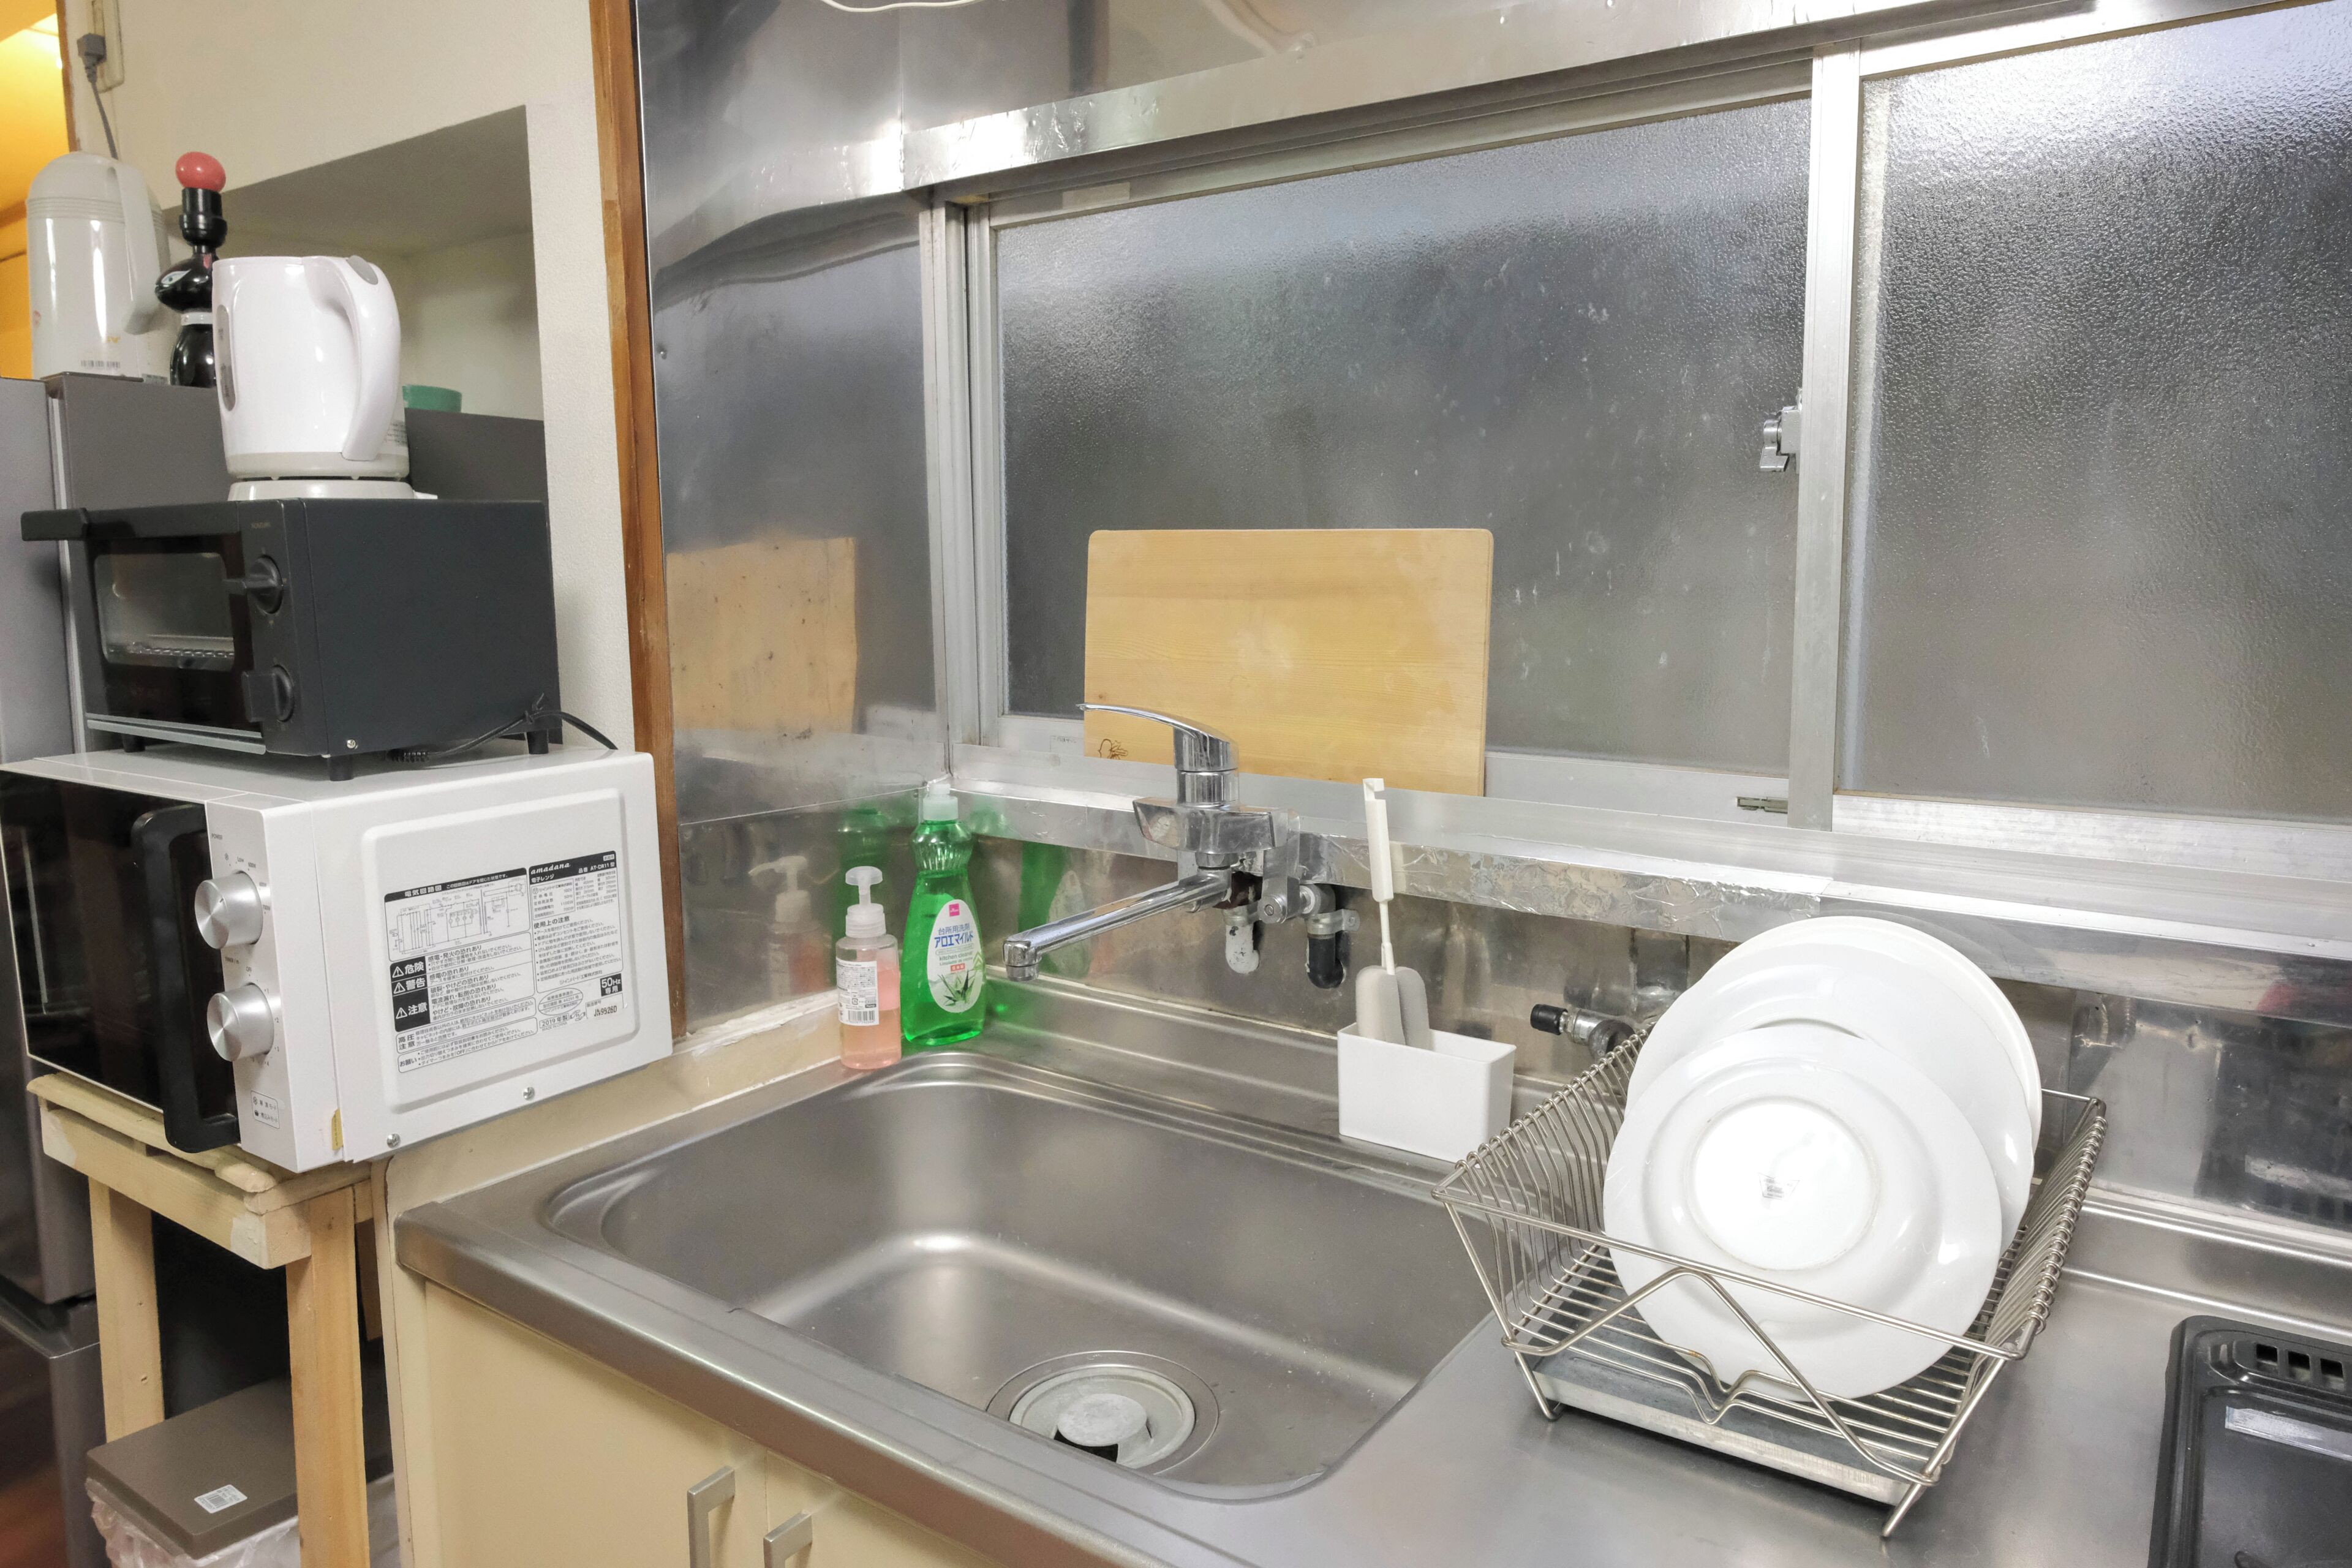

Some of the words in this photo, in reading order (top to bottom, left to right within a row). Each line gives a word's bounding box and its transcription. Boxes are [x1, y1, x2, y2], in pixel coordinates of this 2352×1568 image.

[530, 862, 570, 874] amadana
[531, 873, 554, 883] 電子レンジ
[404, 884, 442, 899] 電気回路図
[533, 915, 570, 930] 使用上の注意
[938, 923, 970, 935] 台所用洗剤
[934, 931, 973, 948] アロエマイルド
[404, 960, 424, 976] 危険
[428, 943, 482, 963] 感電・発火の恐れあり
[405, 975, 426, 991] 警告
[429, 965, 469, 981] 感電の恐れあり
[430, 973, 489, 994] 破裂・やけどの恐れあり
[601, 978, 621, 989] 50Hz
[604, 984, 618, 995] 専用
[407, 1000, 428, 1016] 注意
[431, 982, 497, 1006] 電波漏れ・転倒の恐れあり
[432, 995, 491, 1017] やけど・故障の恐れあり
[398, 1033, 415, 1044] 高圧
[398, 1040, 415, 1051] 注意
[399, 1057, 417, 1068] お願い
